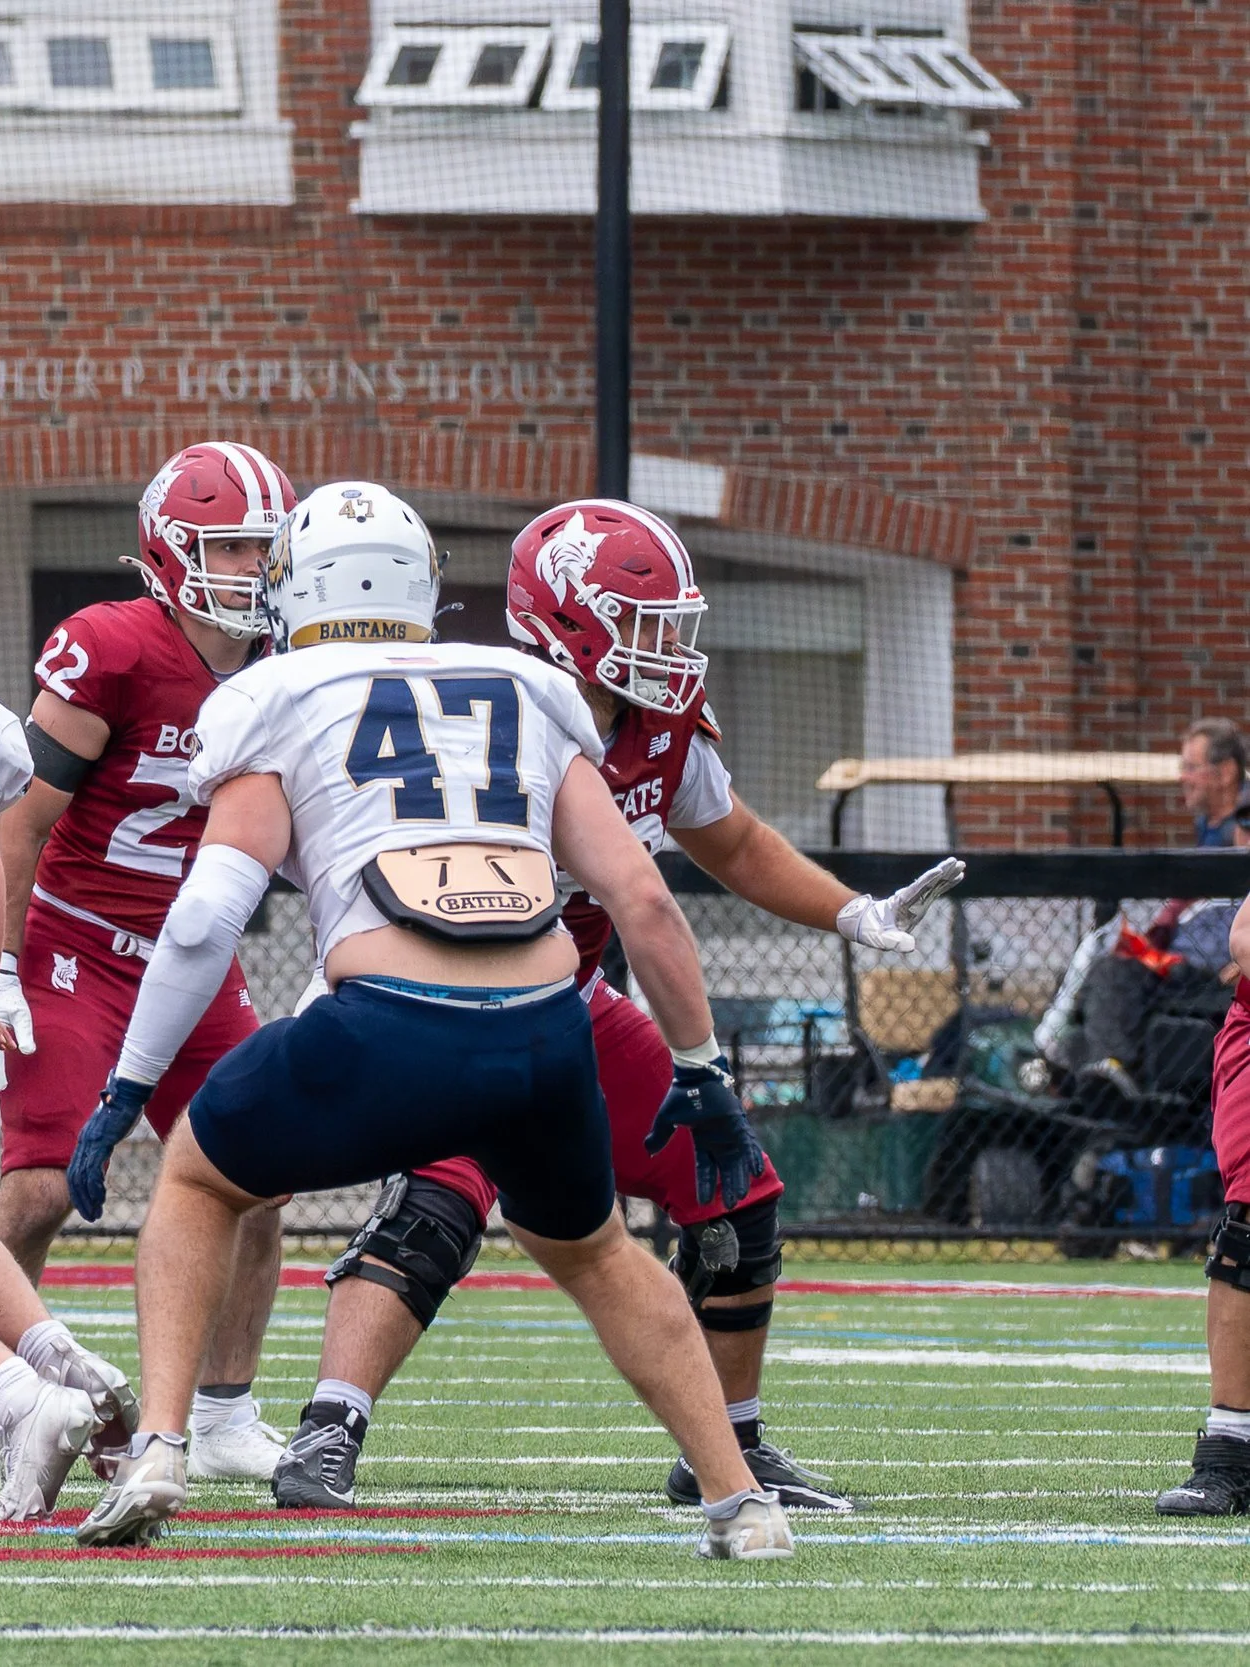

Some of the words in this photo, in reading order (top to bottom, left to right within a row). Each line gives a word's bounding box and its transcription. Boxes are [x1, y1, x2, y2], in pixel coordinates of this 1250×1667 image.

[177, 357, 407, 401] HOPKINS
[338, 499, 375, 519] 47
[319, 621, 408, 641] BANTAMS
[34, 627, 90, 701] 22
[342, 674, 530, 831] 47
[445, 896, 525, 911] BATTLE
